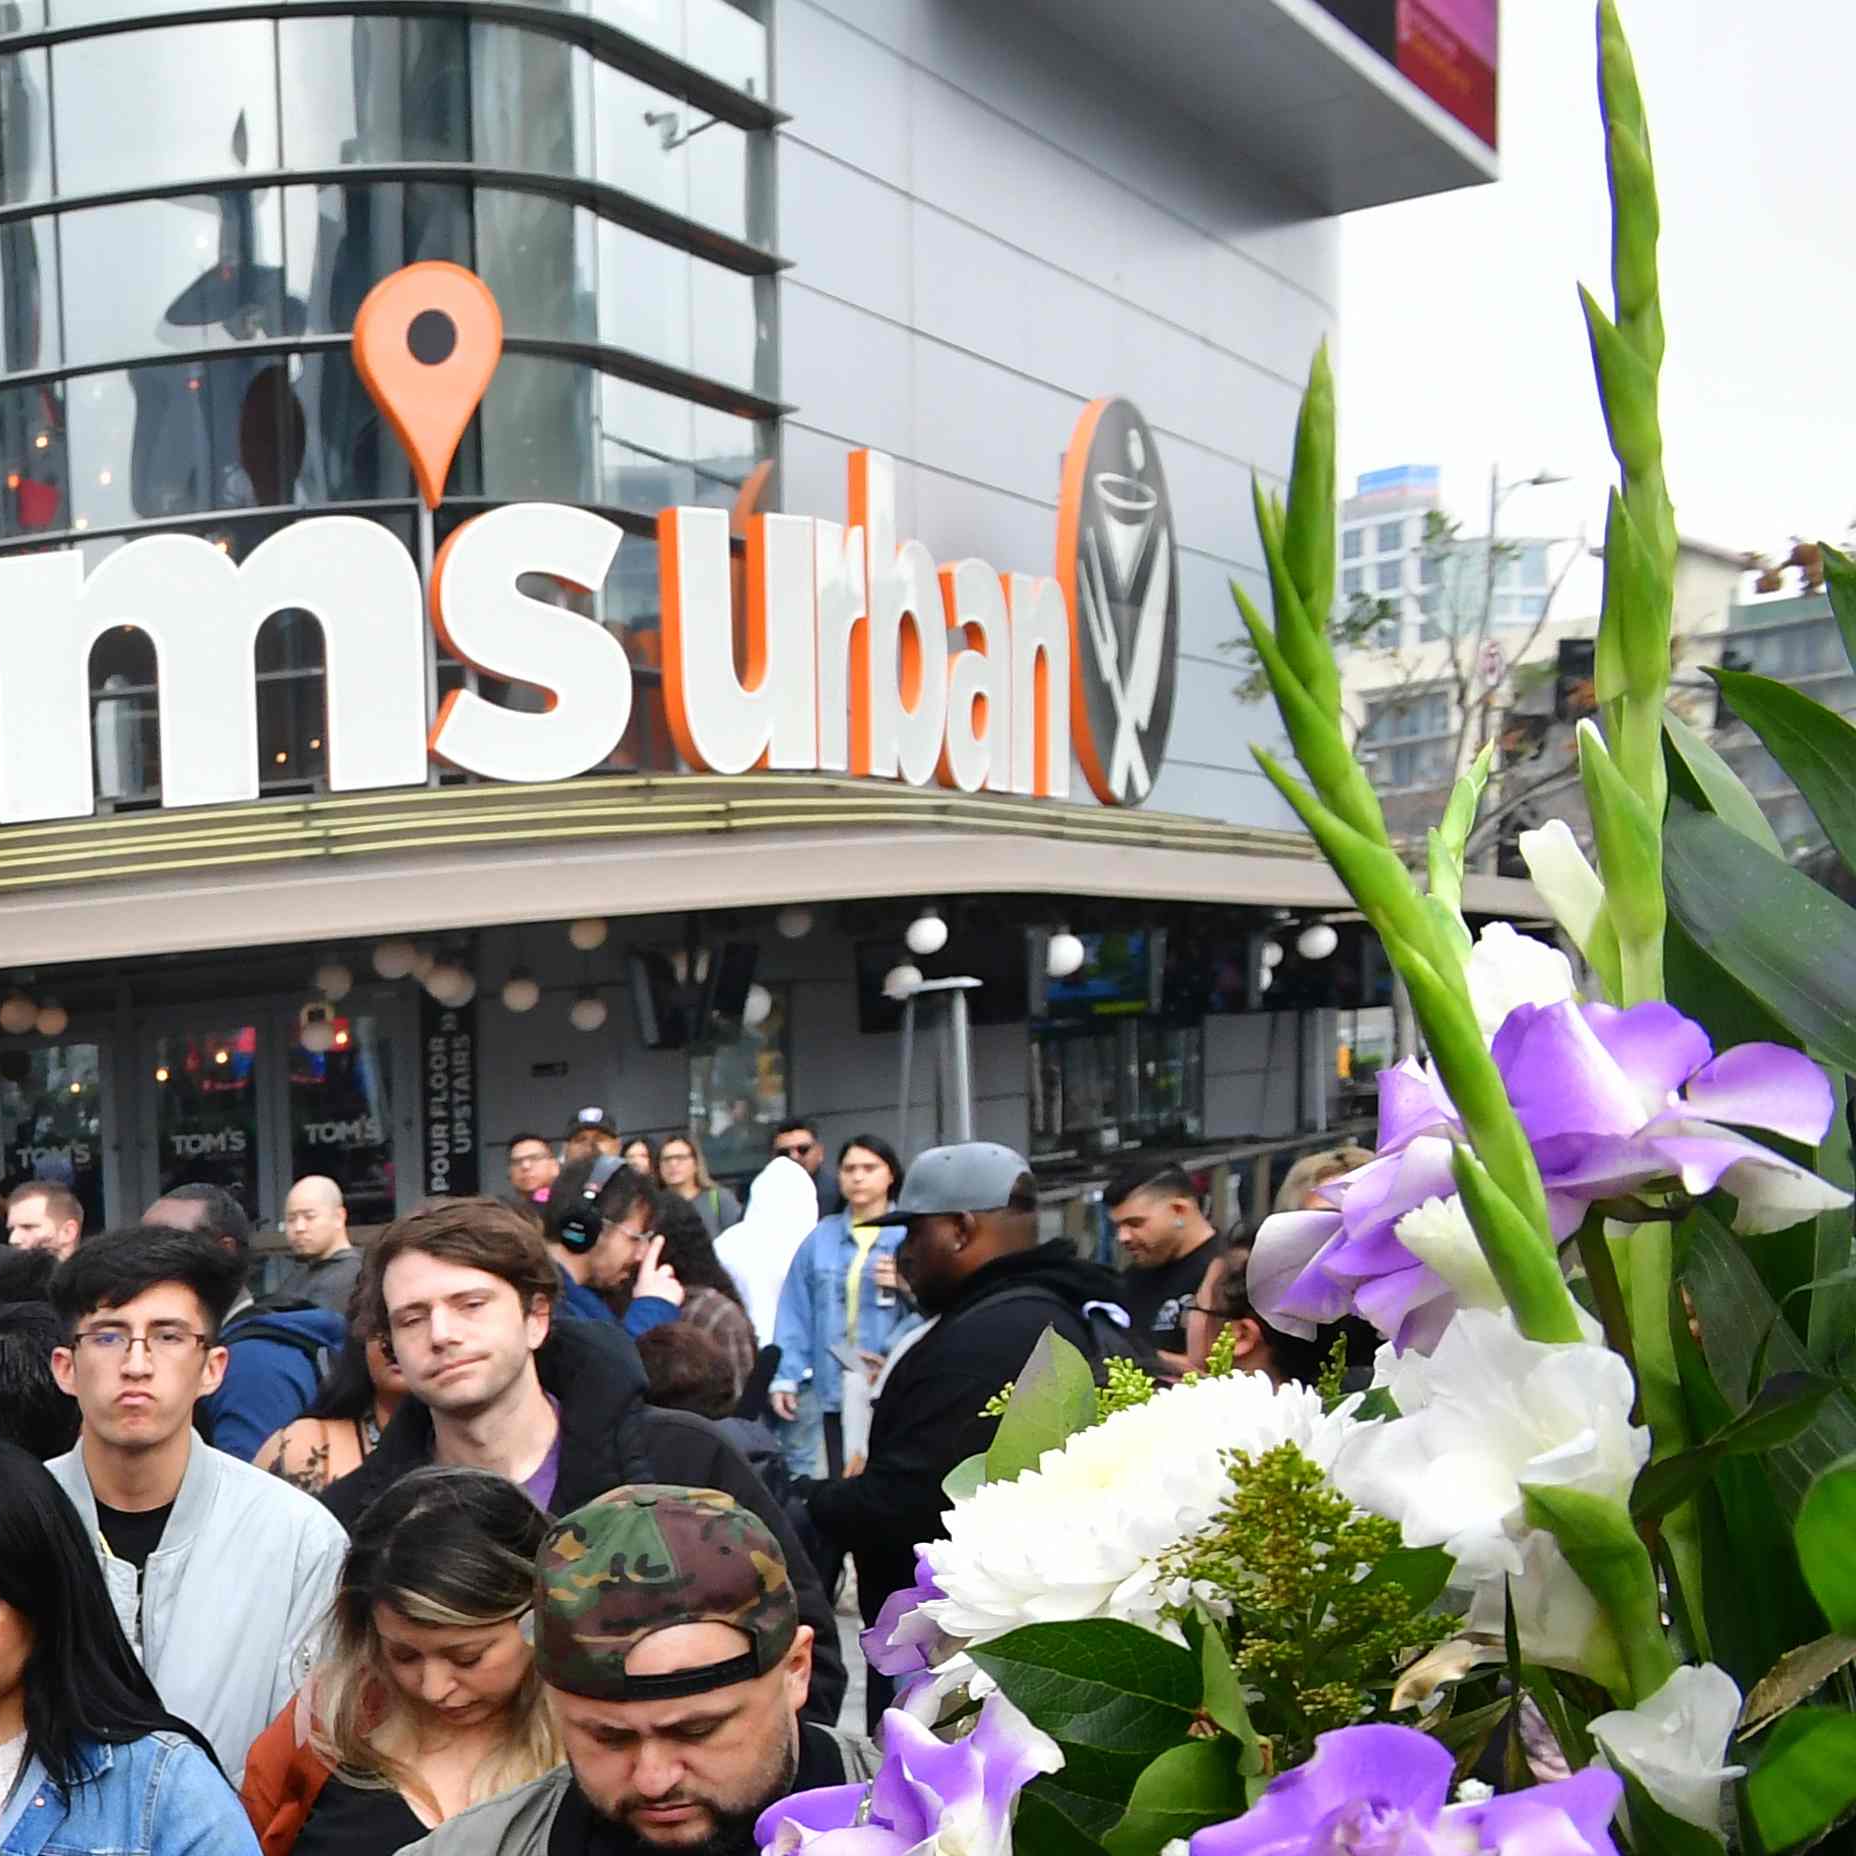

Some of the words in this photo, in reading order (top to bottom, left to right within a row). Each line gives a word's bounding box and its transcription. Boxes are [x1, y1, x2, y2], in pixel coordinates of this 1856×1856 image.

[658, 449, 1071, 800] urban
[428, 1036, 449, 1119] FLOOR
[452, 1033, 473, 1155] UPSTAIRS
[170, 1126, 247, 1155] TOM'S
[430, 1123, 450, 1192] POUR
